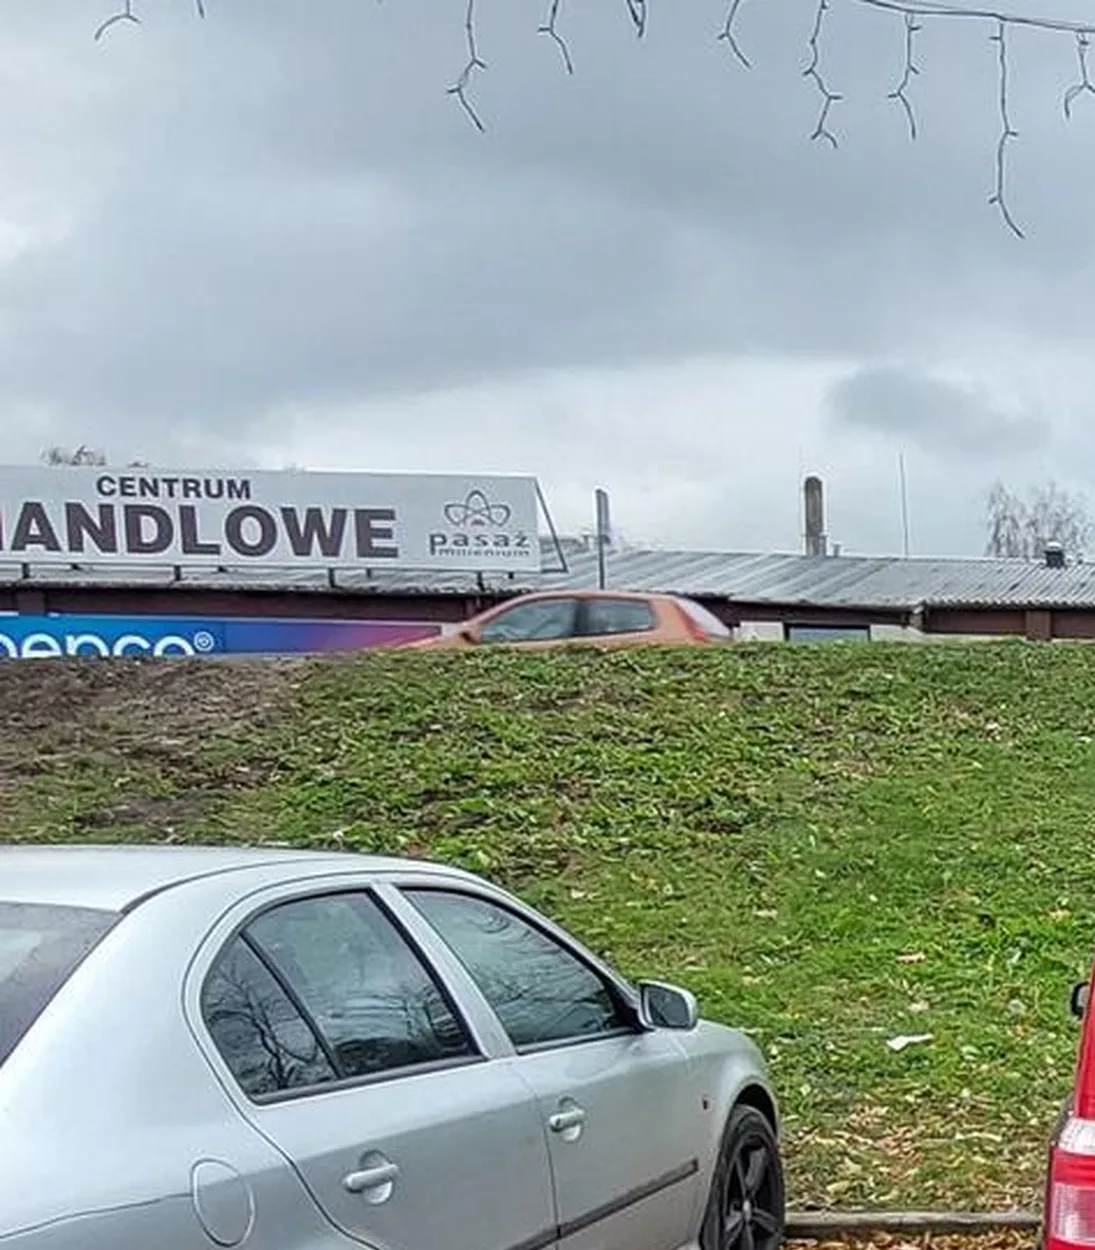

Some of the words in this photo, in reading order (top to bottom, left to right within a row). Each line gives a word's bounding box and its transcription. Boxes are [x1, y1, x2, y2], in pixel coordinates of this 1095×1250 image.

[96, 476, 251, 500] CENTRUM
[0, 501, 399, 558] ANDLOWE
[428, 531, 531, 556] pasaż
